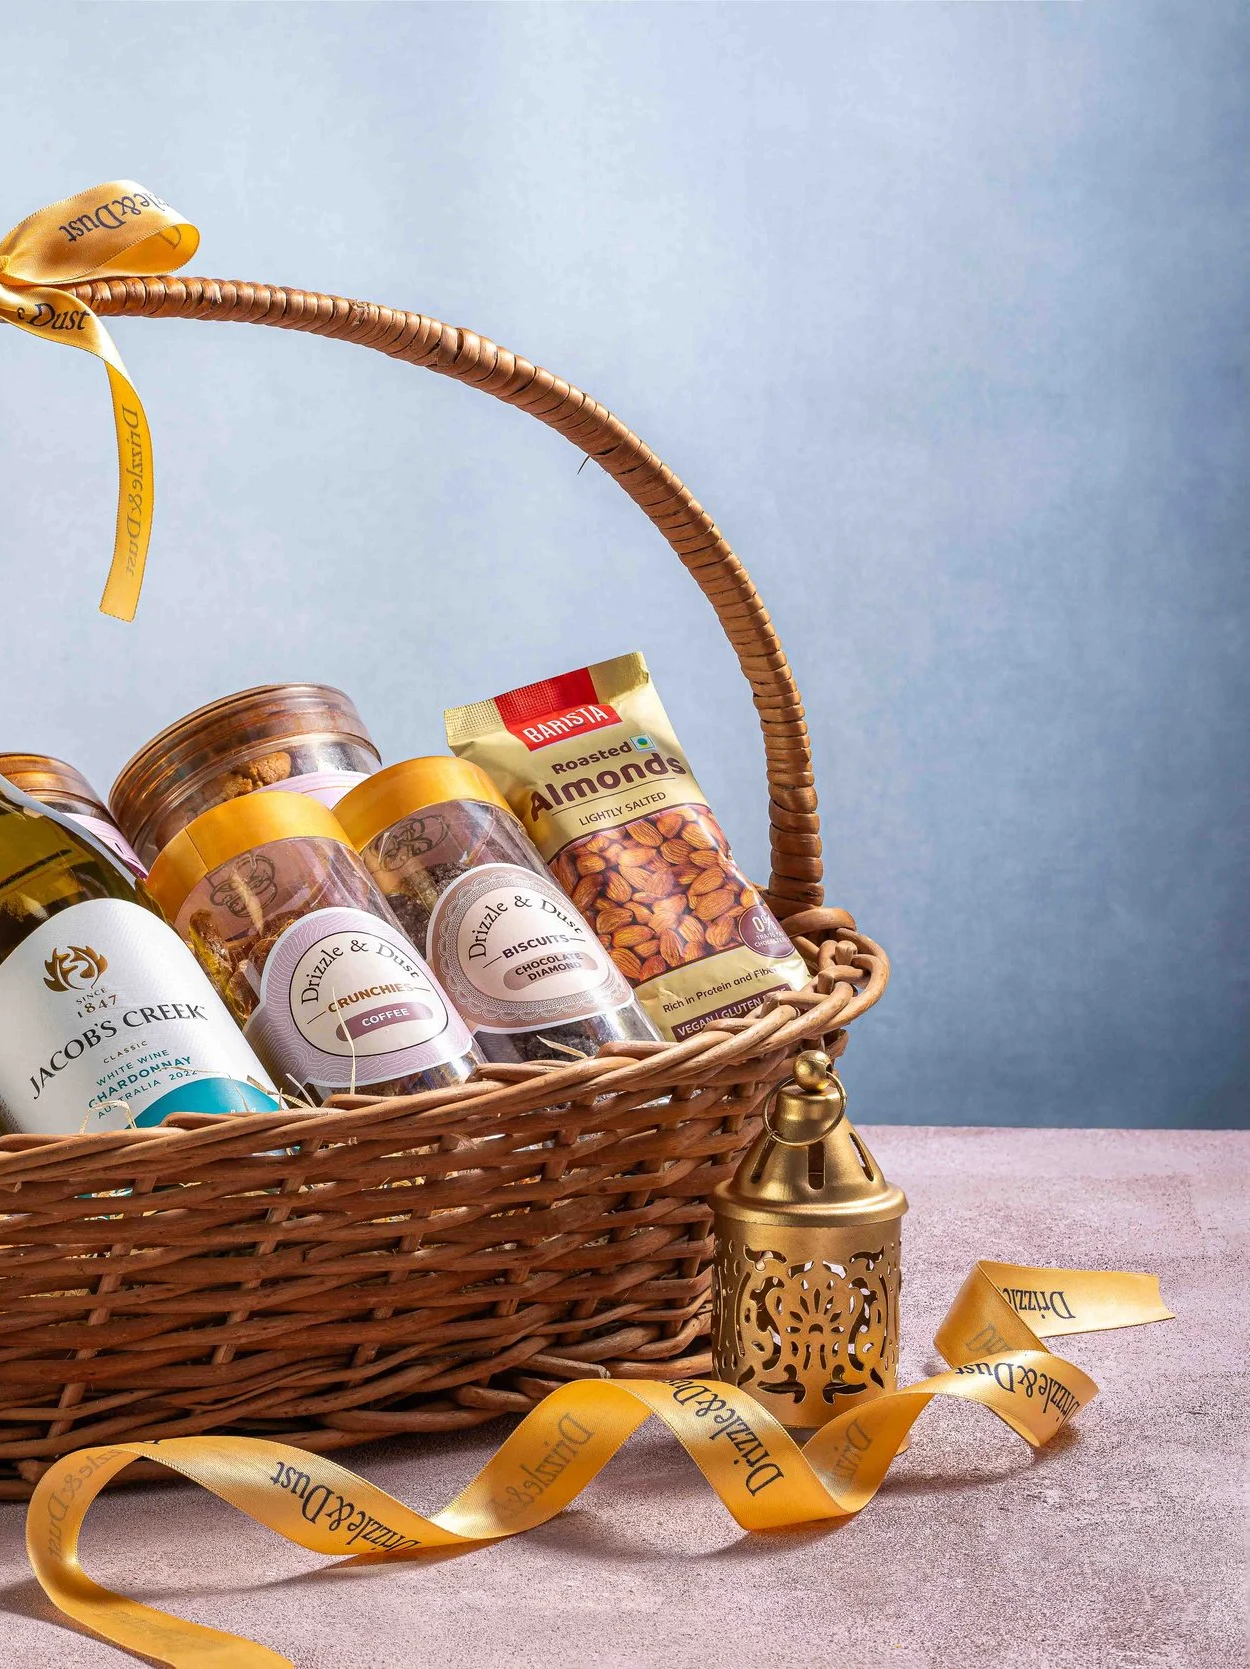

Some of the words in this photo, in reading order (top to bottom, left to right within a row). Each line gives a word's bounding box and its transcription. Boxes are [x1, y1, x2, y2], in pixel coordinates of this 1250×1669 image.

[523, 705, 609, 743] BARISTA
[551, 741, 632, 774] Roasted
[530, 753, 687, 822] Almonds
[579, 806, 623, 826] LIGHTLY
[627, 791, 666, 812] SALTED
[469, 901, 508, 960] Drizzle
[514, 895, 532, 908] &
[539, 899, 583, 934] Dust
[501, 934, 570, 959] BISCUITS
[301, 947, 344, 1005] Drizzle
[350, 939, 369, 952] &
[375, 943, 420, 978] Dust
[515, 952, 583, 976] CHOCOLATE
[527, 961, 582, 981] DIAMOND
[76, 988, 107, 1004] SINCE
[77, 994, 117, 1018] 1847
[328, 983, 415, 1013] CRUNCHIES
[663, 1000, 685, 1013] Rich
[686, 995, 695, 1005] in
[696, 982, 732, 1001] Protein
[734, 973, 752, 986] and
[362, 1008, 410, 1027] COFFEE
[29, 1020, 118, 1100] JACOB'S
[122, 1003, 208, 1028] CREEK
[96, 1062, 134, 1087] WHITE
[137, 1049, 170, 1064] WINE
[103, 1040, 148, 1064] CLASSIC
[88, 1056, 192, 1109] CHARDONNAY
